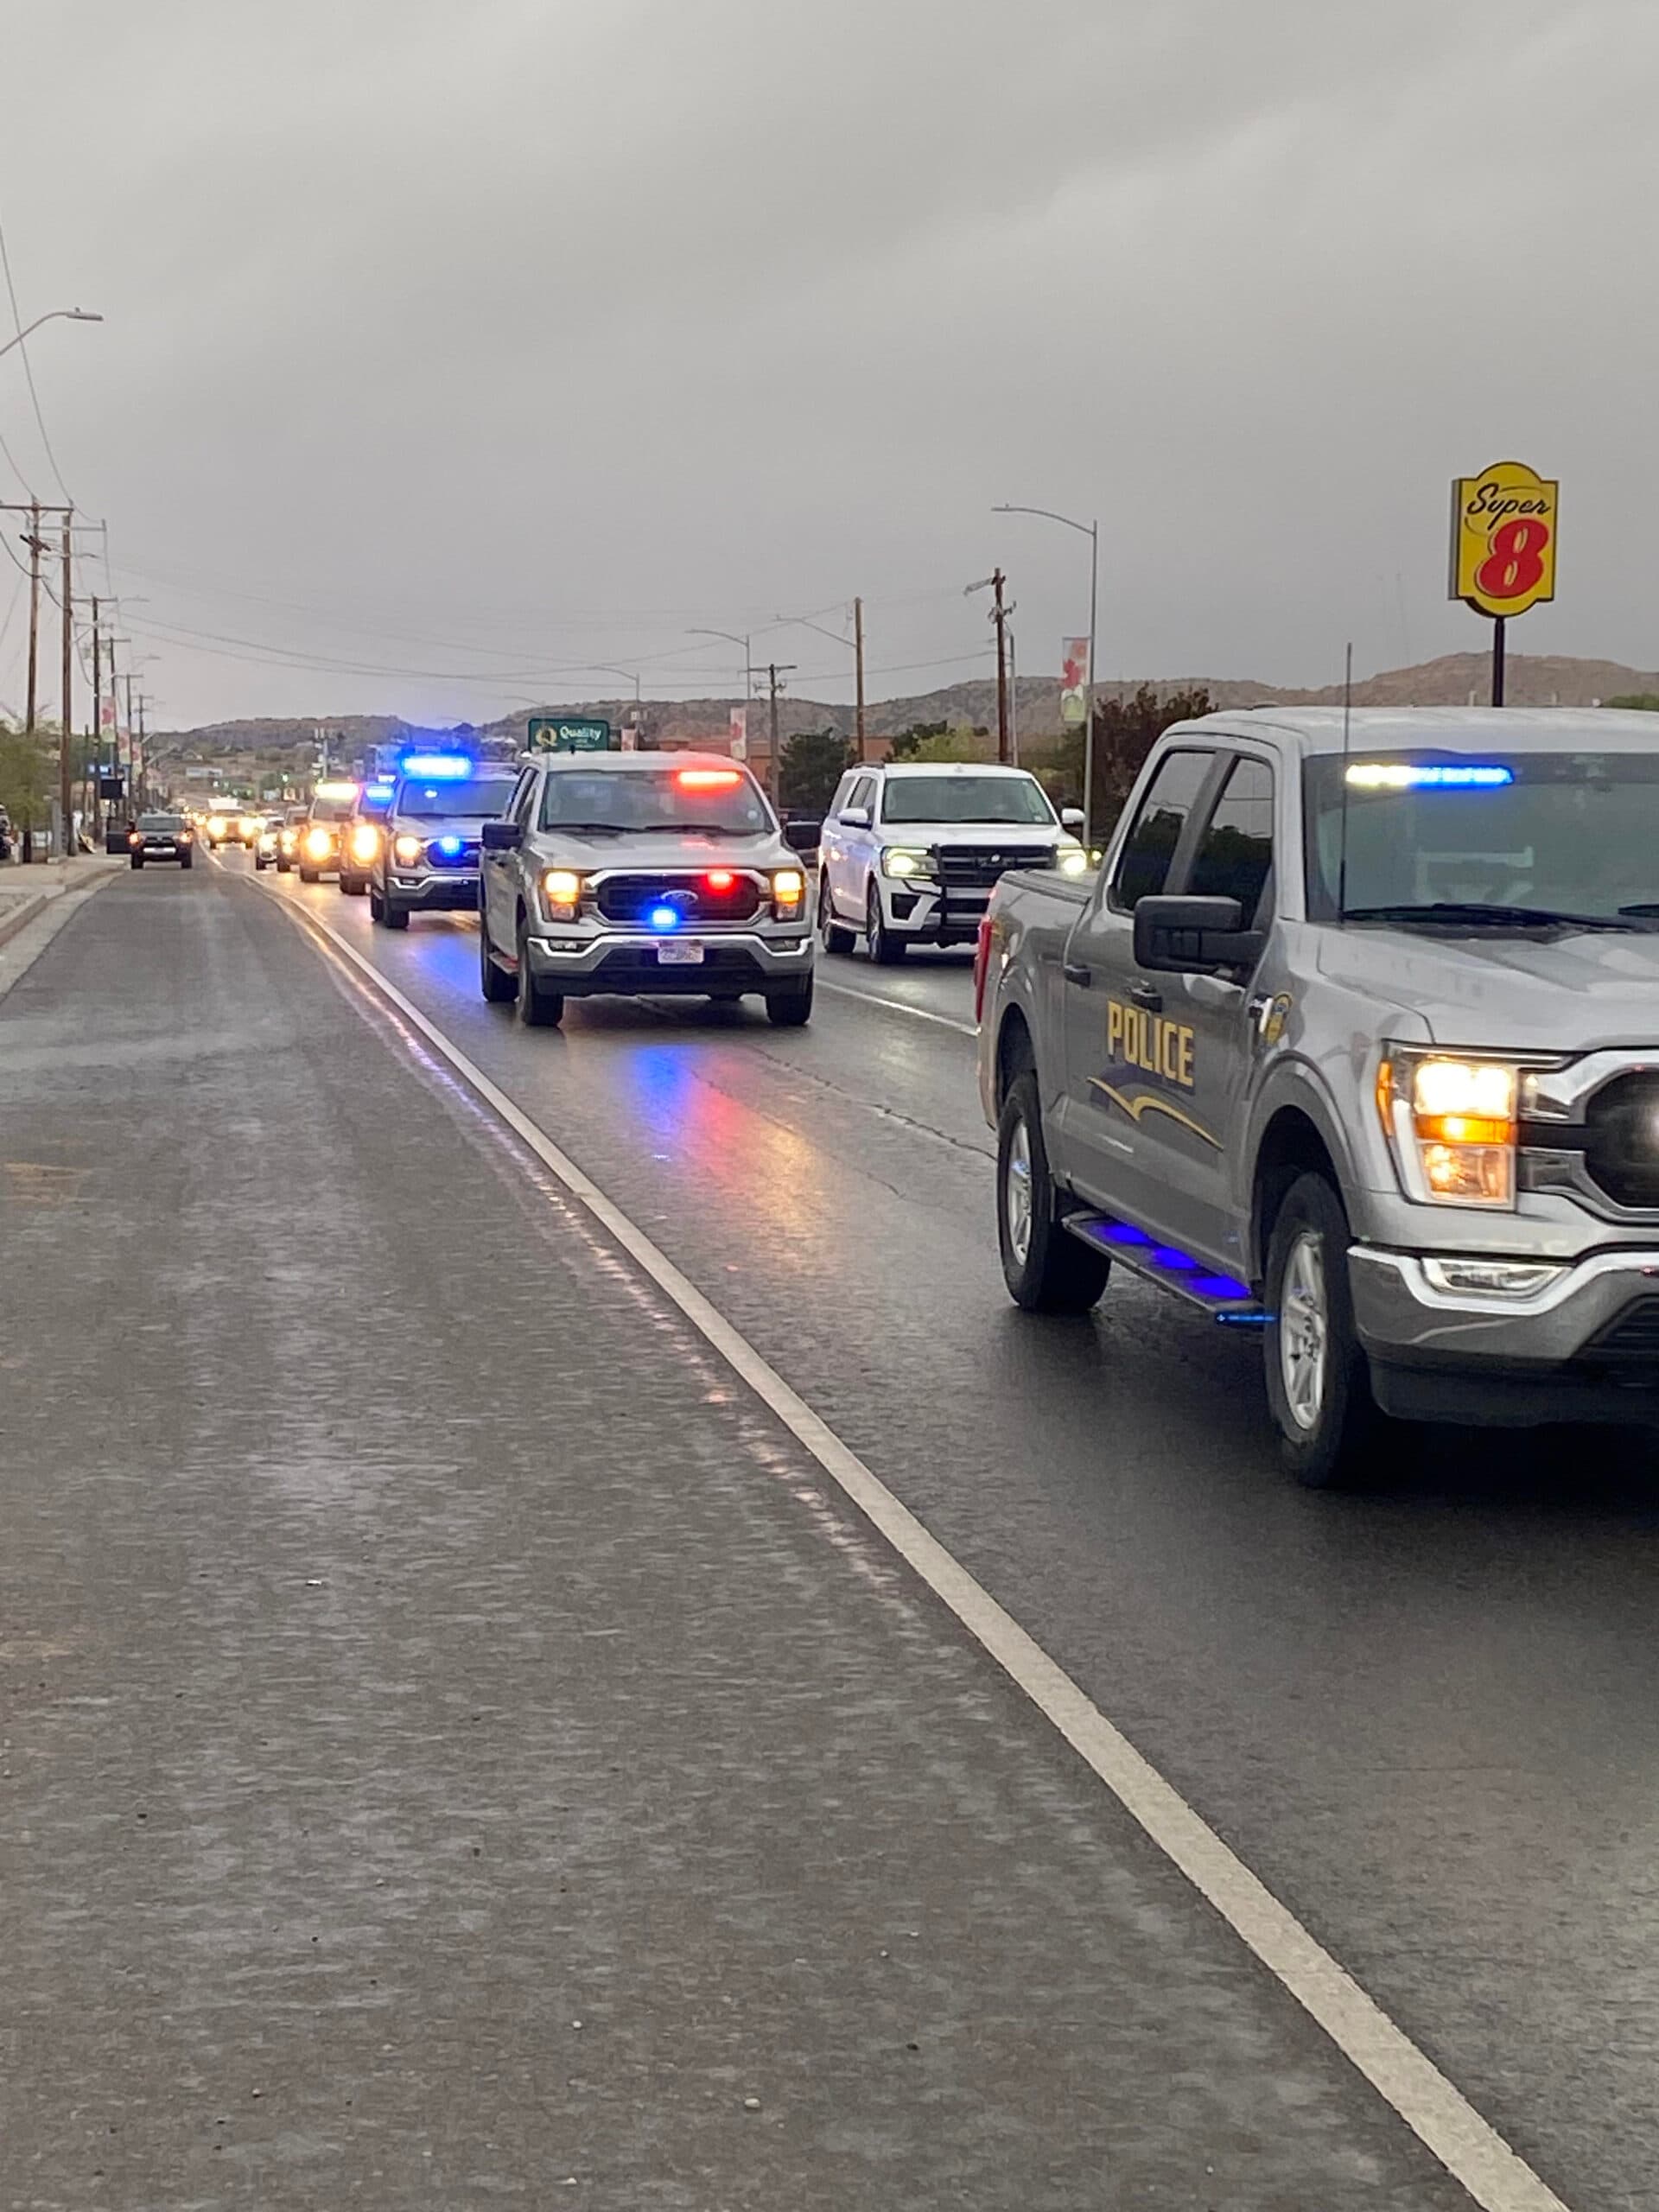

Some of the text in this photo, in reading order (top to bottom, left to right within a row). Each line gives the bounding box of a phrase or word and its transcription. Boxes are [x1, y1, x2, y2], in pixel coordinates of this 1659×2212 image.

[1466, 482, 1551, 531] Super
[1475, 518, 1549, 599] 8
[559, 726, 601, 741] Quality
[1108, 1001, 1194, 1087] POLICE
